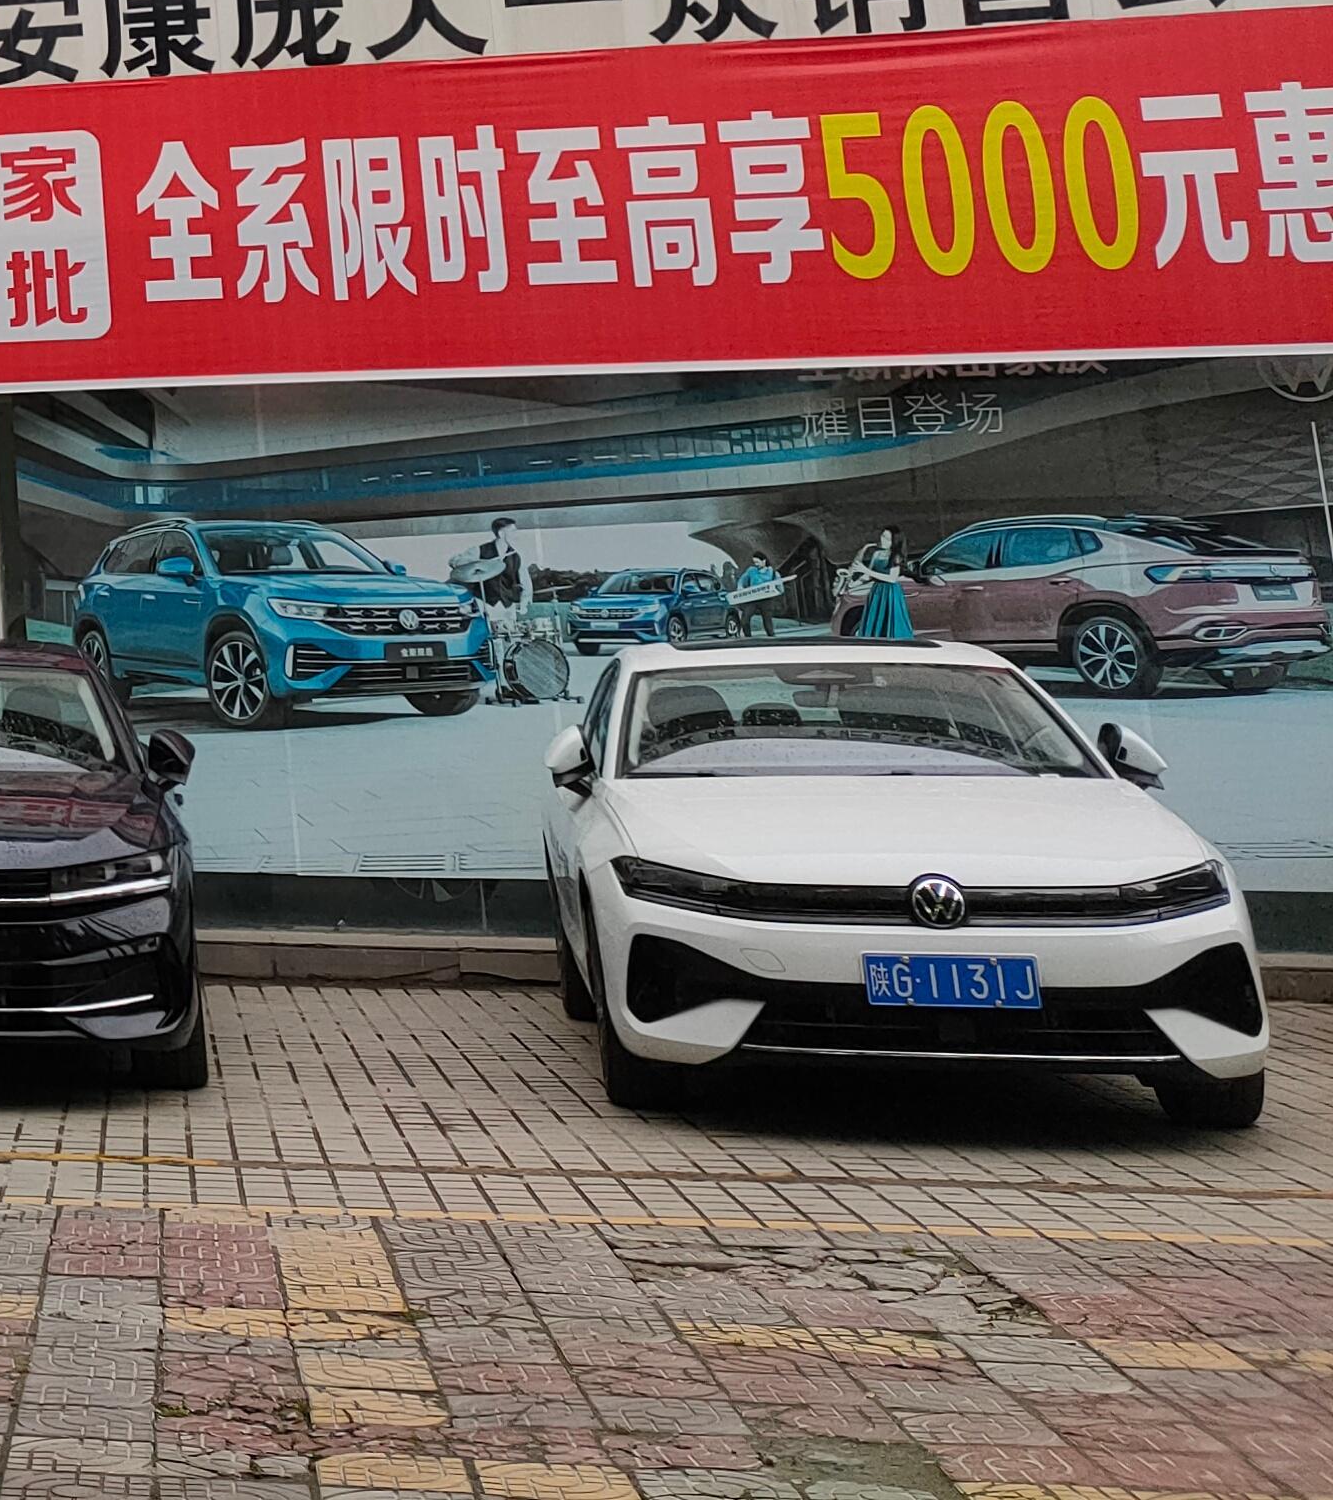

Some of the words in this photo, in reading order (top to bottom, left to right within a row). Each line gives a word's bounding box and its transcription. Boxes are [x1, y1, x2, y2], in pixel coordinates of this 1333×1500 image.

[136, 82, 1333, 304] 全系限时至高享5000元惠
[802, 392, 1004, 438] 耀目登场
